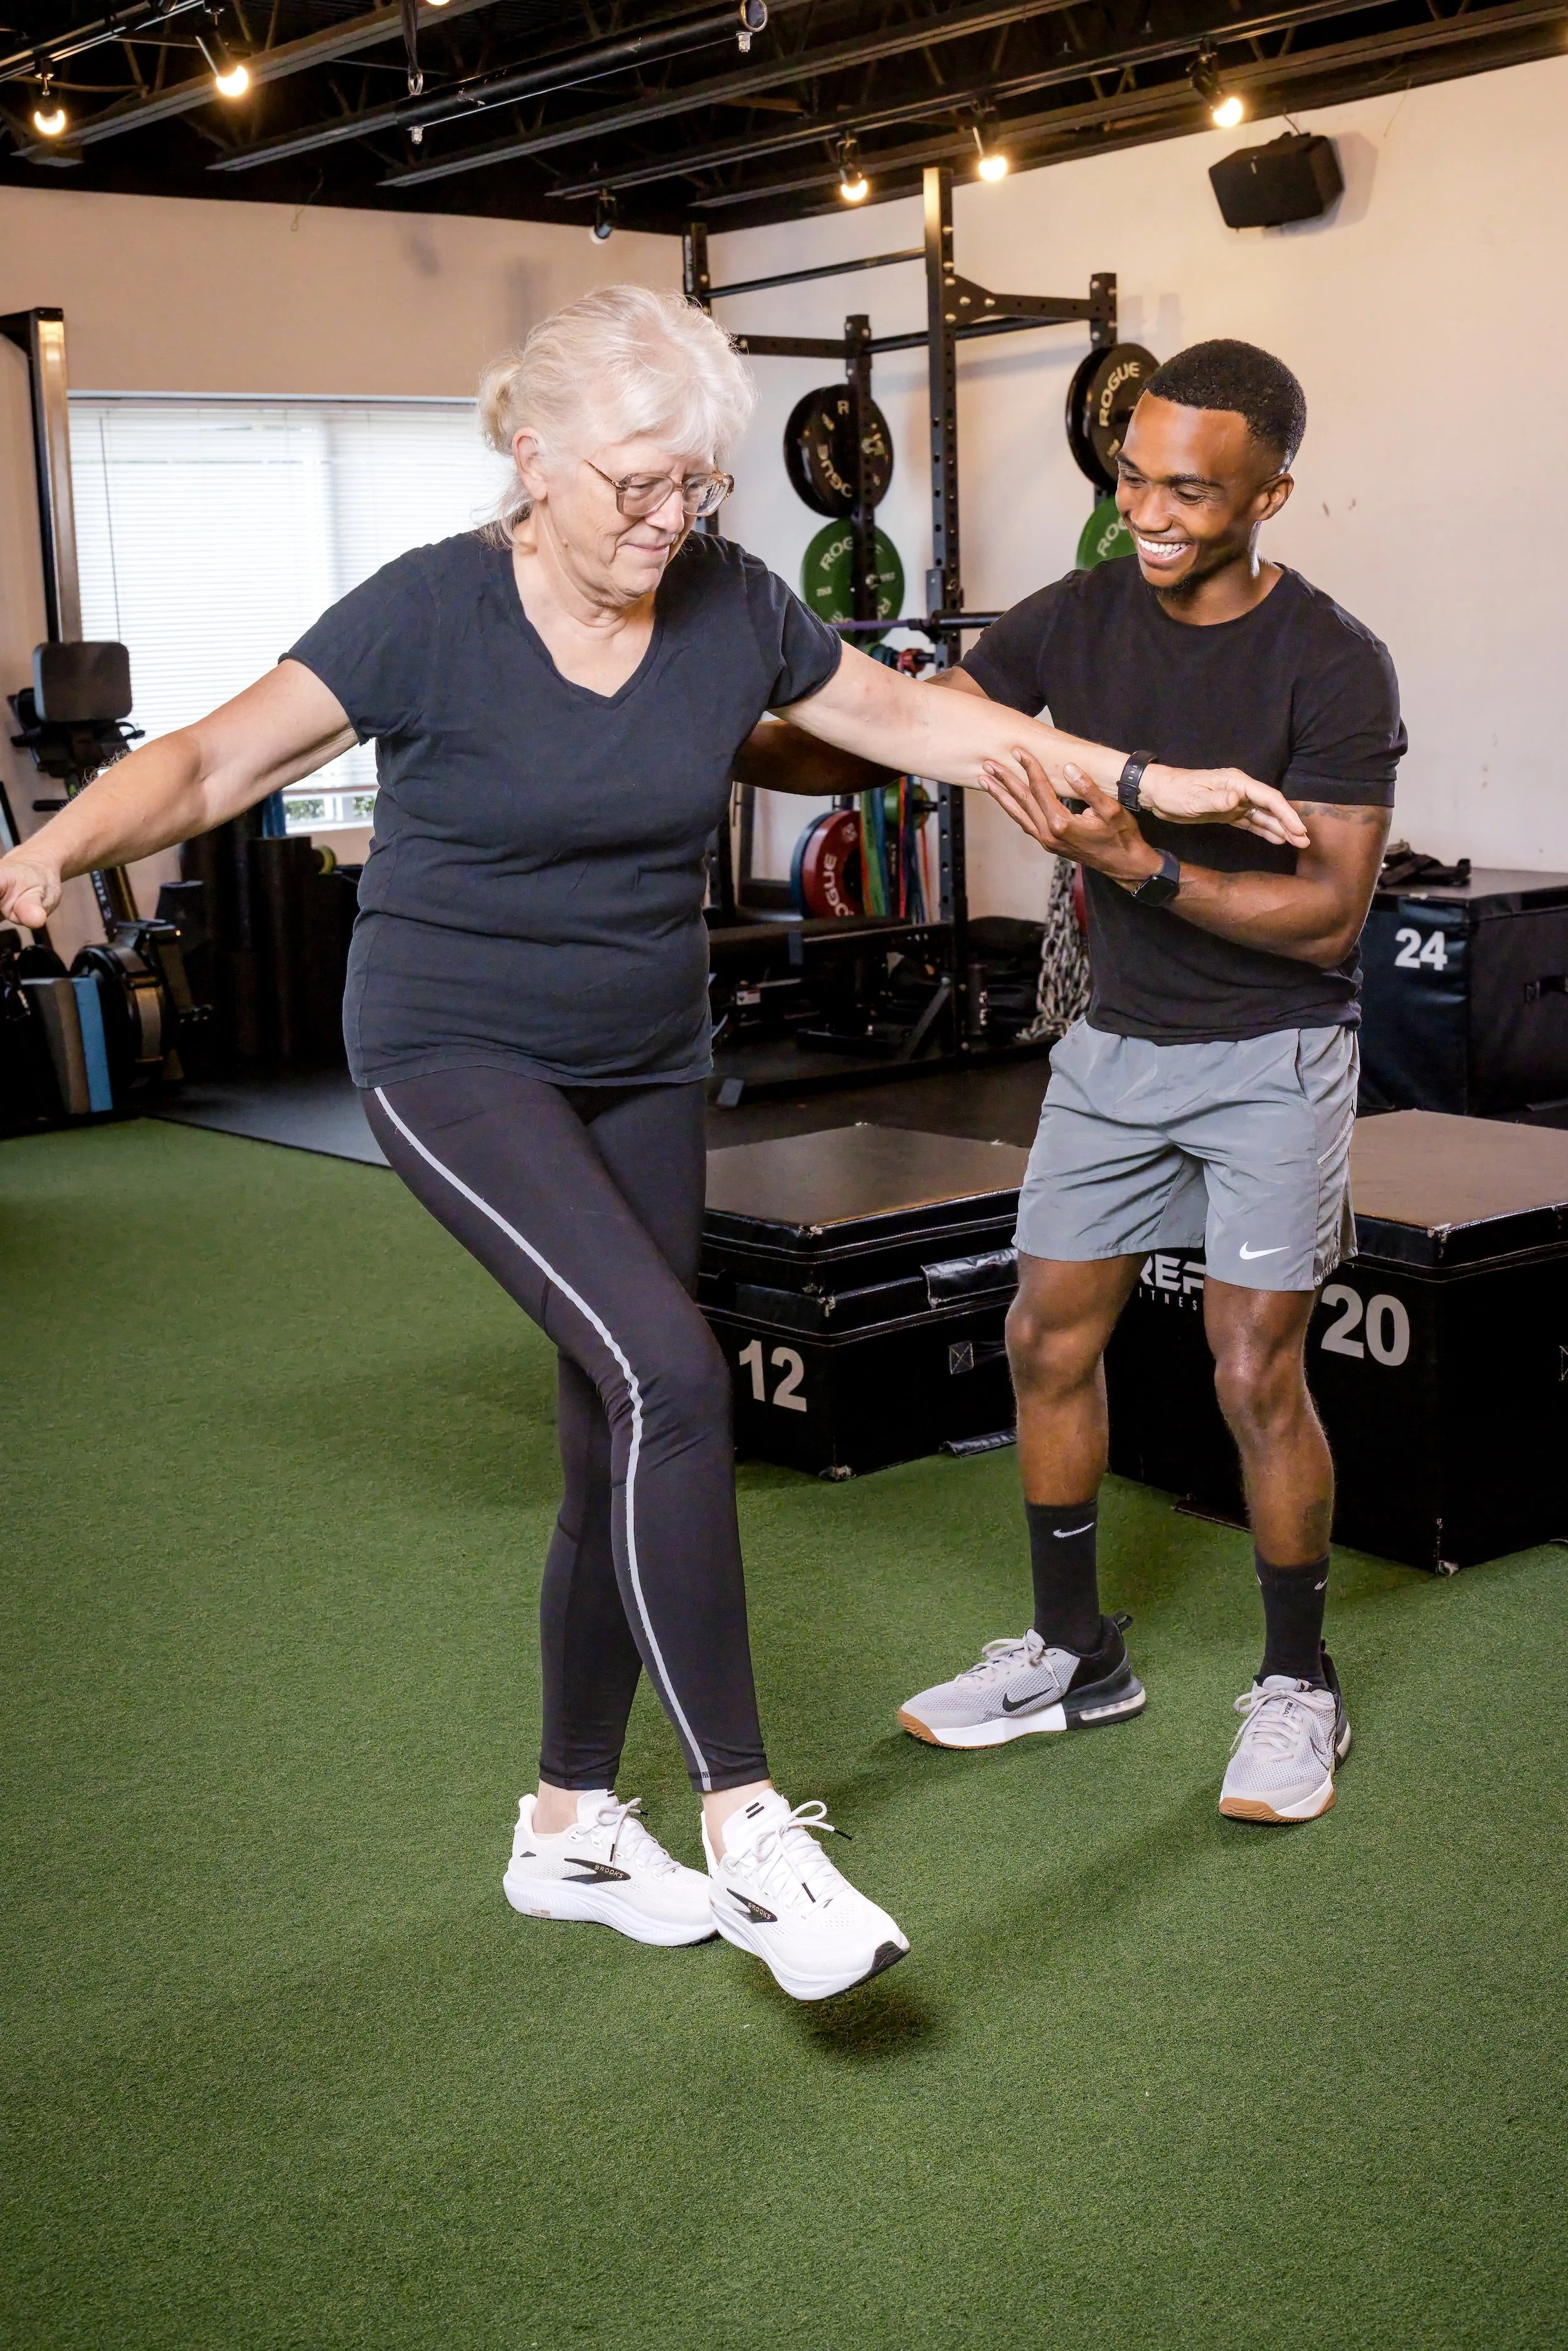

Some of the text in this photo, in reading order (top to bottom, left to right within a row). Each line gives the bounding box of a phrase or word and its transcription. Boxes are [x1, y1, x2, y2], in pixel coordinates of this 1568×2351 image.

[1099, 361, 1140, 427] ROGUE
[822, 853, 854, 917] OGUE
[1395, 928, 1448, 971] 24
[1138, 1287, 1197, 1311] ITNES
[1321, 1284, 1410, 1366] 20
[739, 1339, 807, 1412] 12
[595, 1865, 624, 1879] BROOKS
[748, 1901, 771, 1919] BROOKS
